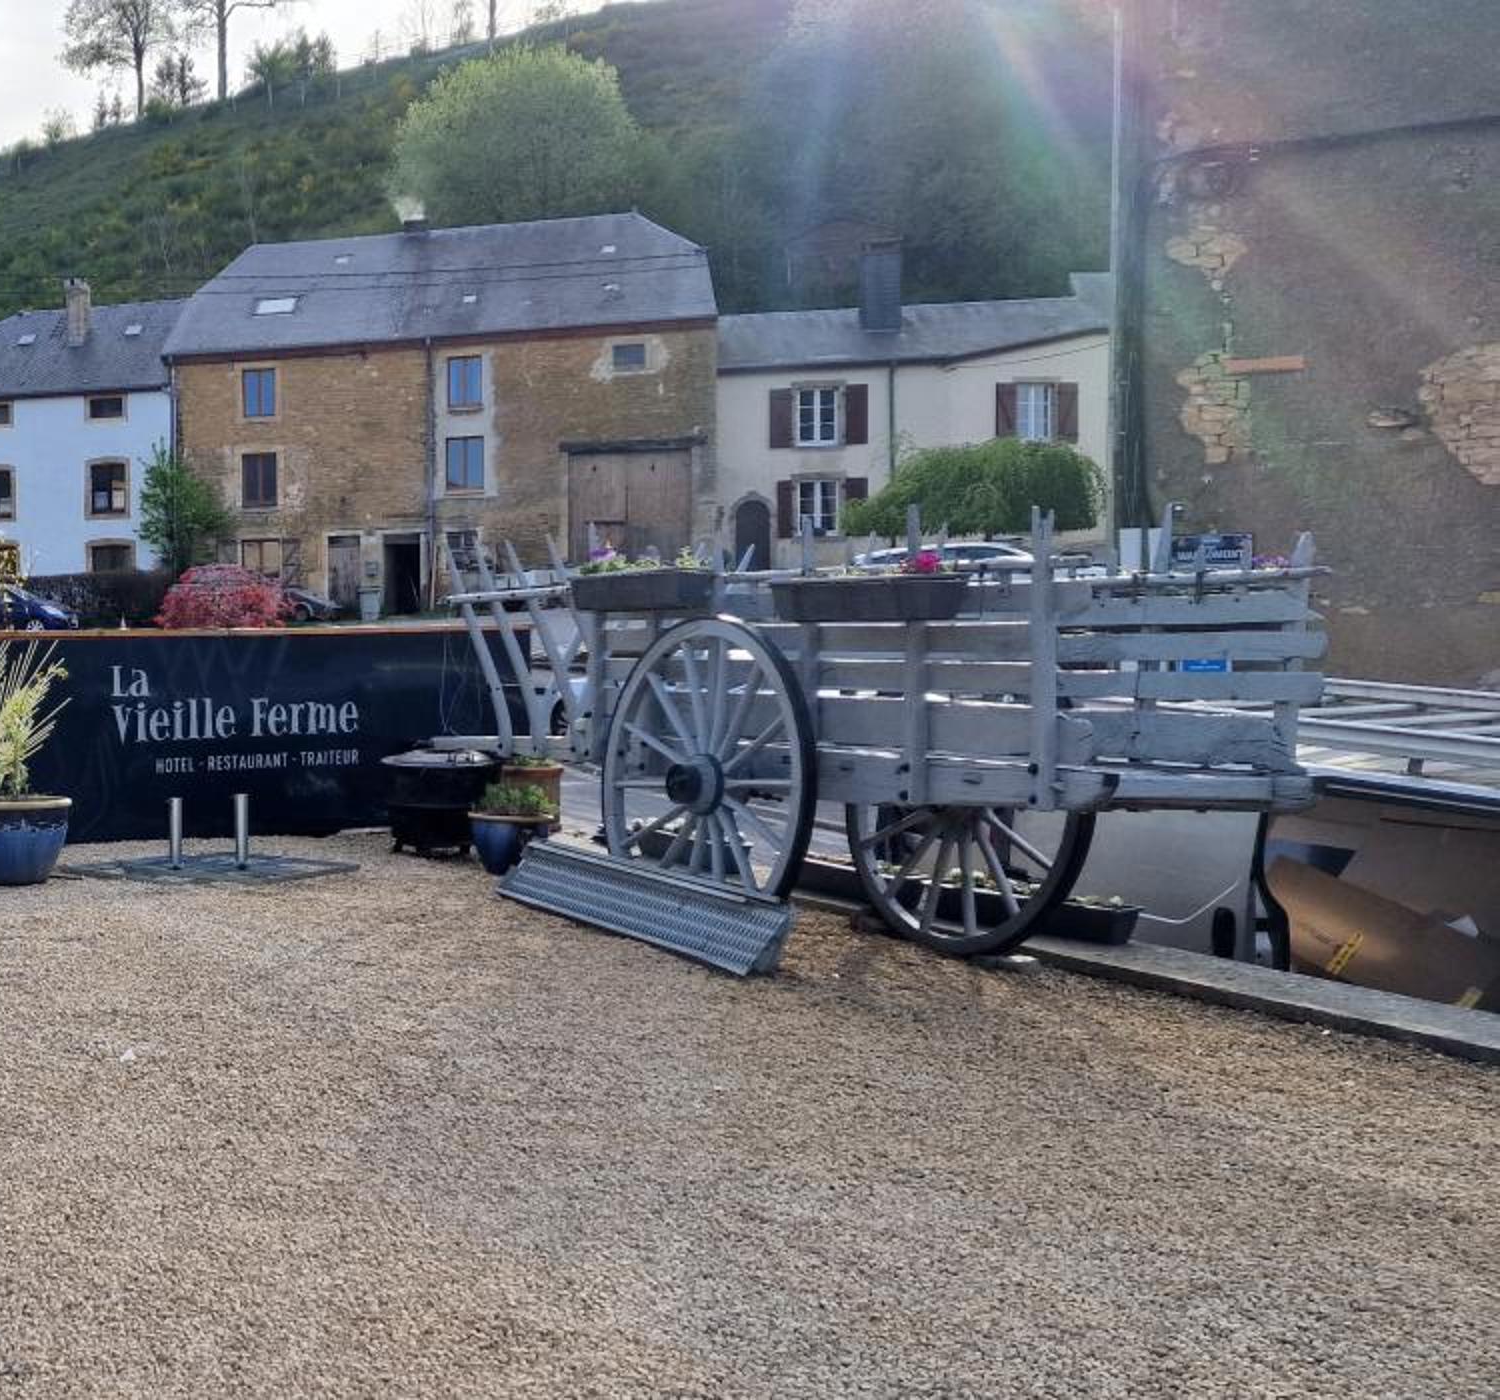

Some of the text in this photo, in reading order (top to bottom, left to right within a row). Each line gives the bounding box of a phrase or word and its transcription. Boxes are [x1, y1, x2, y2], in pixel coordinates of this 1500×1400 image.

[108, 665, 150, 698] La
[110, 698, 359, 745] Vieille Ferme
[155, 756, 195, 774] HOTEL
[207, 752, 289, 772] RESTAURANT
[300, 749, 360, 767] TRAITEUR
